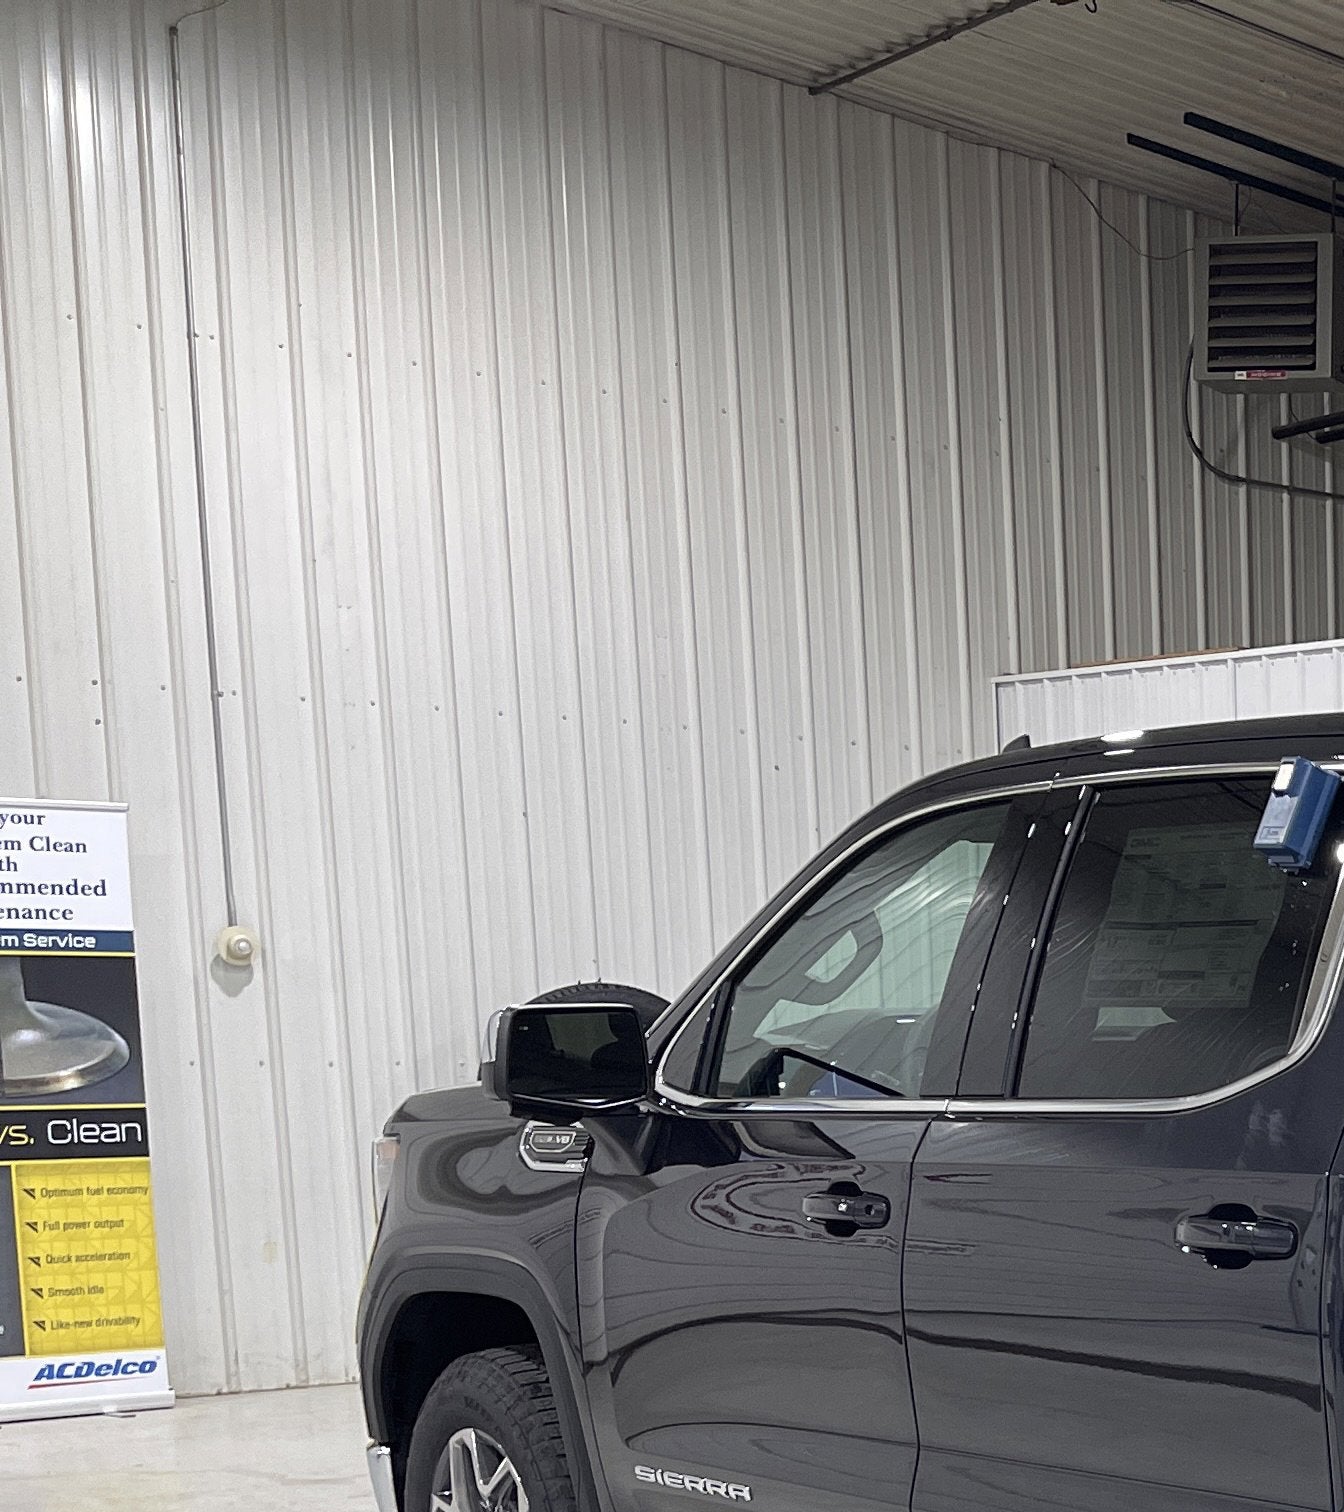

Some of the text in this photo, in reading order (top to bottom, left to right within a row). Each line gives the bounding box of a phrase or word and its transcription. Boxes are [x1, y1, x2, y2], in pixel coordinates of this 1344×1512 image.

[29, 835, 88, 854] Clean
[22, 933, 97, 949] Service
[47, 1118, 142, 1144] Clean
[33, 1358, 158, 1382] ACDelco
[634, 1464, 752, 1502] SIERRA
